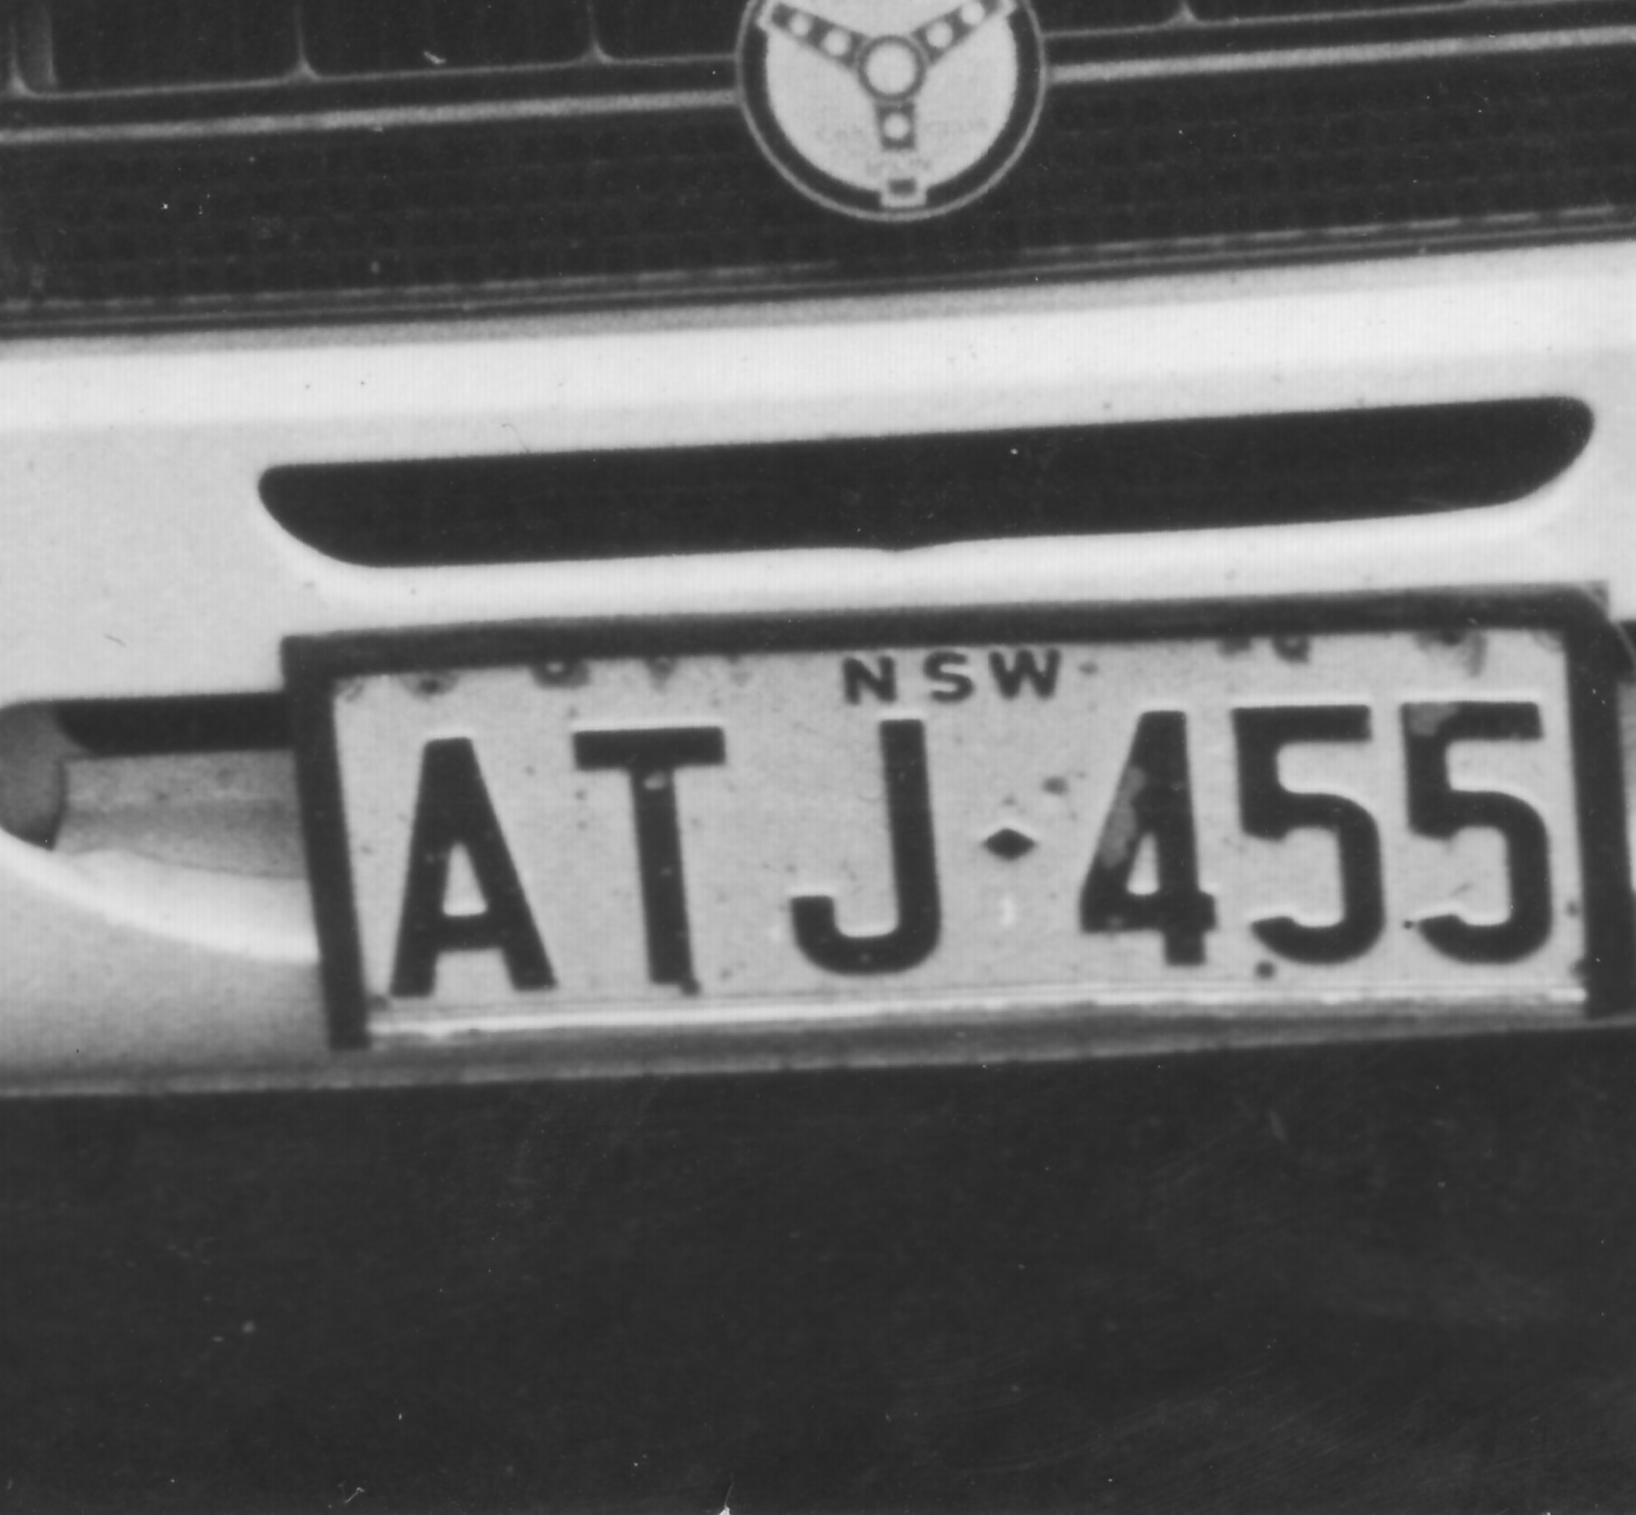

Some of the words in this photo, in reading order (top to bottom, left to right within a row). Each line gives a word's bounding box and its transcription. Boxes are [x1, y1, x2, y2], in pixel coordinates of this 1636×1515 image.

[840, 648, 1066, 706] NSW
[388, 717, 944, 999] ATJ
[1077, 700, 1555, 969] 455
